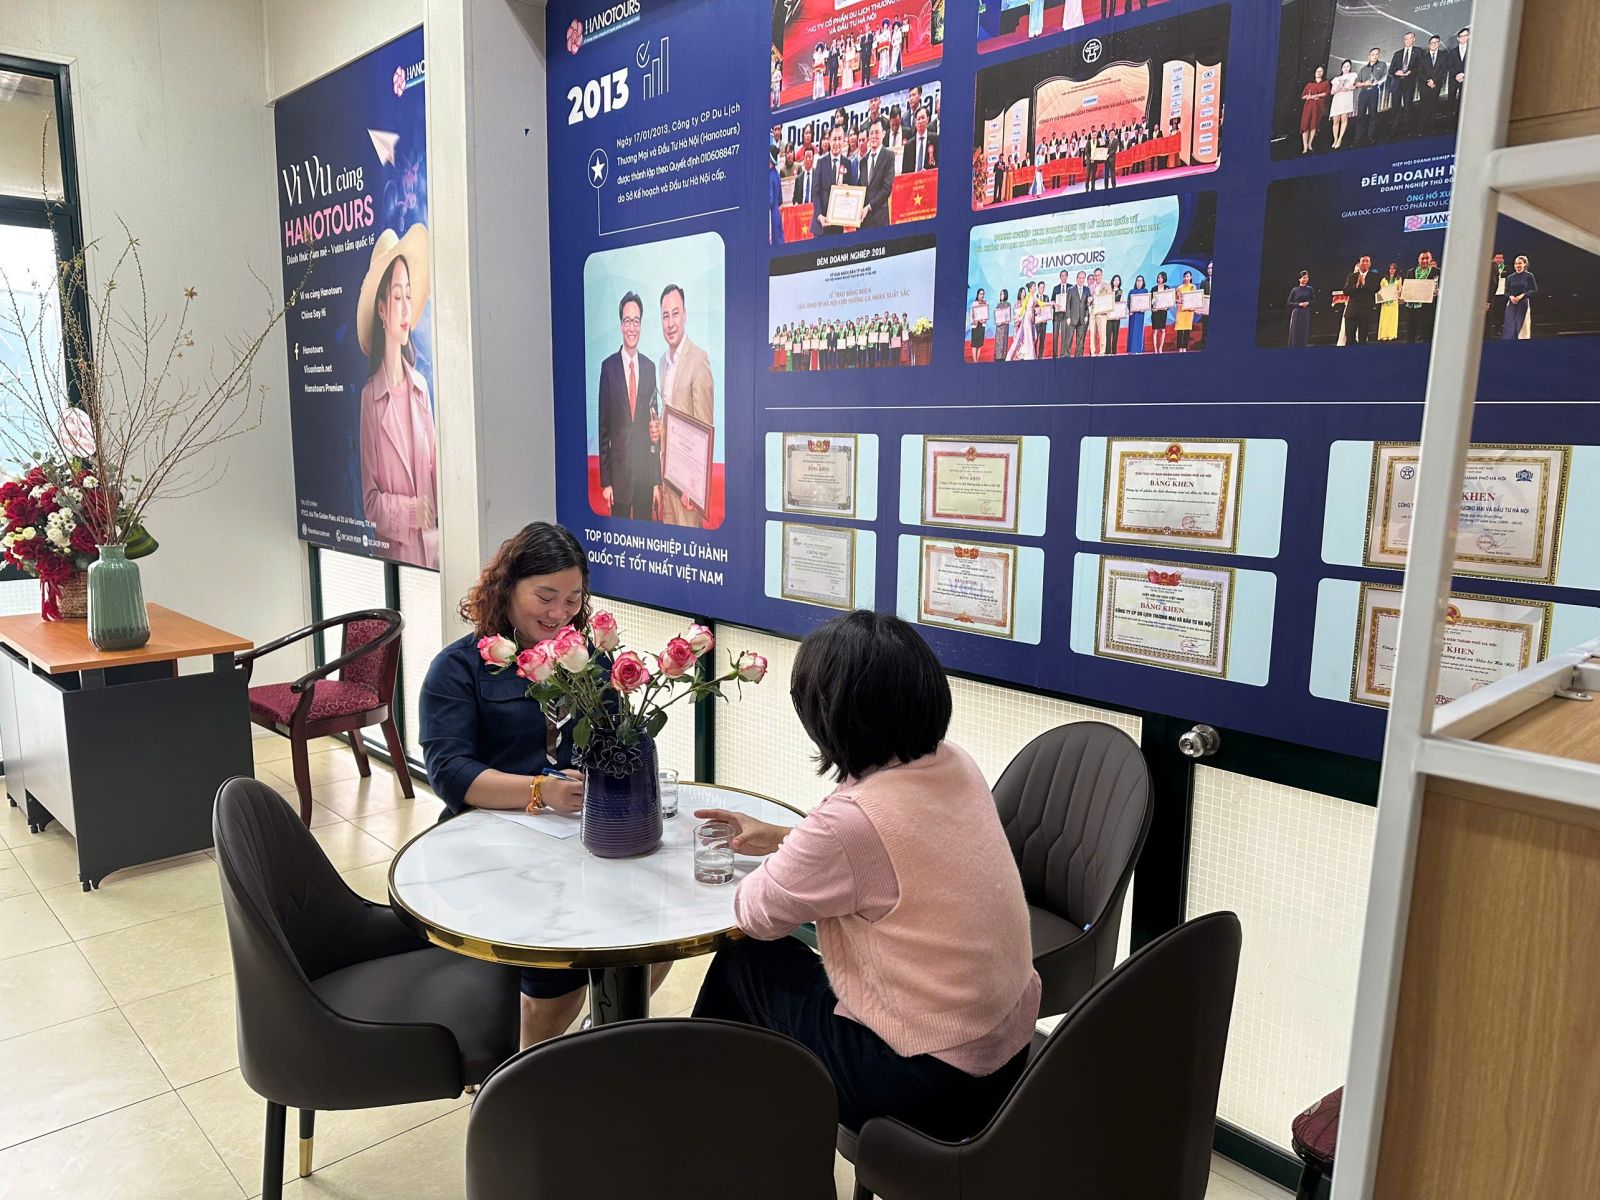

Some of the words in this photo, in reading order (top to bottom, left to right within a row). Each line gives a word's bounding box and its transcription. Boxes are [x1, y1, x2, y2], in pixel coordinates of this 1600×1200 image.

[406, 60, 425, 80] HANO
[567, 67, 629, 126] 2013
[616, 136, 632, 149] Ngày
[671, 119, 690, 132] Công
[692, 117, 699, 127] ty
[700, 110, 710, 123] CP
[712, 109, 722, 120] Du
[723, 102, 741, 117] Lịch
[616, 153, 637, 166] Thương
[637, 149, 649, 162] Mại
[649, 147, 657, 157] và
[658, 141, 670, 155] Đầu
[671, 140, 679, 151] Tư
[679, 138, 688, 149] Hà
[688, 135, 700, 147] Nội
[700, 122, 741, 145] (Hanotours)
[282, 164, 303, 207] Vi
[304, 154, 332, 200] Vu
[336, 165, 364, 192] cùng
[616, 173, 631, 185] được
[631, 169, 647, 181] thành
[647, 166, 656, 179] lập
[656, 164, 669, 174] theo
[669, 157, 687, 173] Quyết
[687, 155, 700, 168] định
[700, 144, 740, 163] 0106088477
[1361, 173, 1390, 188] ĐÊM
[1393, 165, 1445, 183] DOANH
[617, 193, 625, 204] do
[625, 190, 634, 202] Sở
[633, 187, 641, 200] Kế
[641, 185, 660, 198] hoạch
[660, 182, 668, 193] và
[669, 178, 682, 191] Đầu
[682, 178, 690, 188] tư
[690, 176, 698, 186] Hà
[699, 172, 711, 185] Nội
[711, 168, 727, 182] cấp.
[285, 194, 374, 248] HANOTOURS
[816, 256, 829, 267] ĐÊM
[829, 252, 849, 265] DOANH
[849, 250, 871, 262] NGHIỆP
[871, 246, 886, 258] 2018
[1041, 250, 1105, 269] HANOTOURS
[1149, 478, 1171, 487] BẰNG
[1172, 480, 1195, 488] KHEN
[1462, 492, 1496, 502] KHEN
[585, 528, 602, 543] TOP
[602, 531, 612, 544] 10
[613, 532, 645, 550] DOANH
[646, 538, 682, 557] NGHIỆP
[683, 540, 697, 558] LỮ
[698, 543, 728, 563] HÀNH
[588, 547, 613, 566] QUỐC
[614, 551, 626, 568] TẾ
[629, 553, 646, 572] TỐT
[648, 558, 674, 577] NHẤT
[675, 564, 698, 584] VIỆT
[699, 570, 724, 586] NAM
[1140, 600, 1161, 610] BẰNG
[1162, 604, 1185, 614] KHEN
[1446, 646, 1475, 656] KHEN
